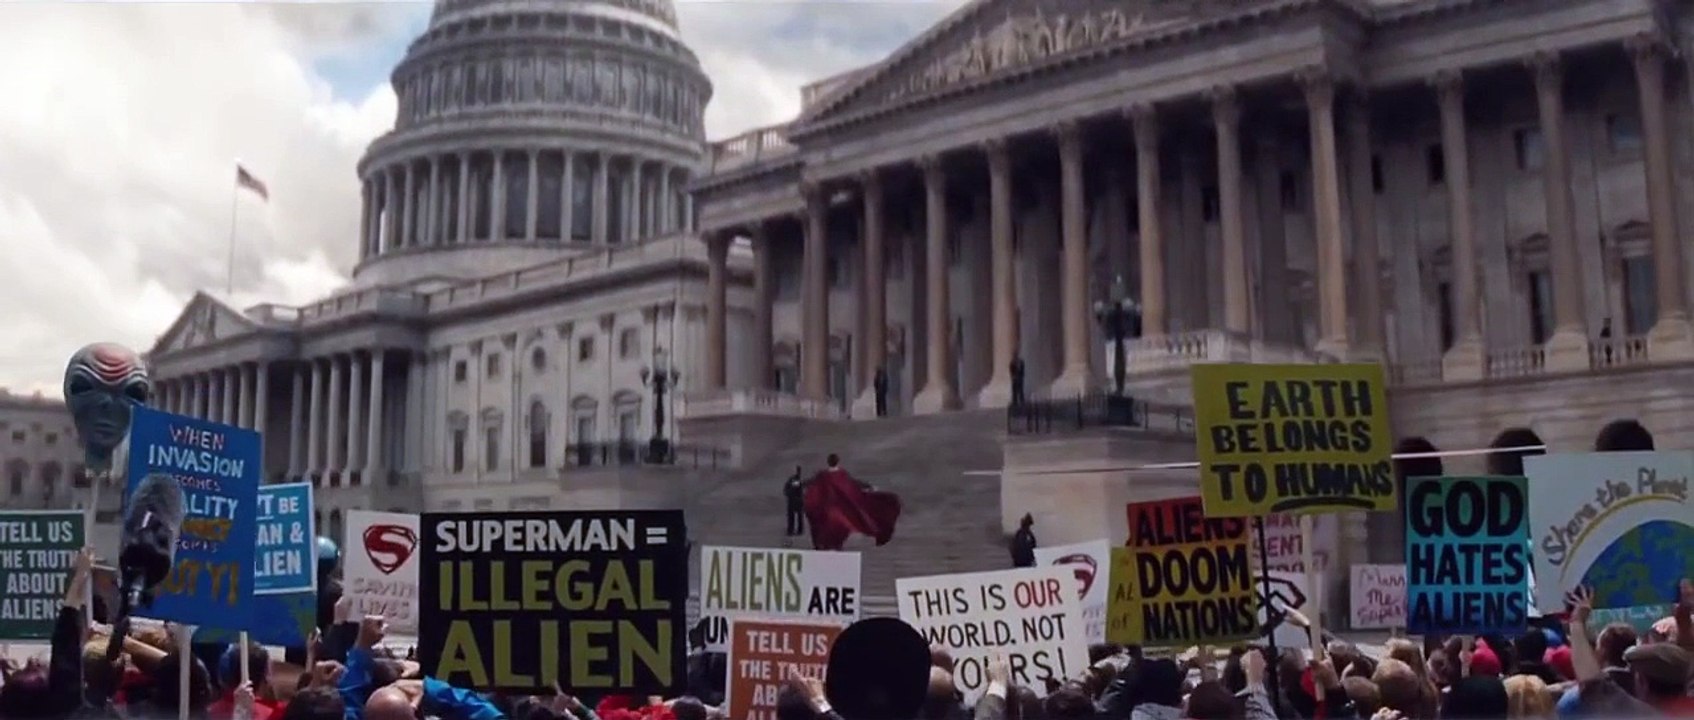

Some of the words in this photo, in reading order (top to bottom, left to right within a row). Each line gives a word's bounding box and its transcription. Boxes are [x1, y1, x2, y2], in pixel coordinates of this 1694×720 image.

[1225, 380, 1373, 419] EARTH
[169, 423, 225, 450] WHEN
[1210, 420, 1372, 454] BELONGS
[148, 443, 244, 479] INVASION
[1210, 463, 1268, 503] TO
[1274, 460, 1393, 498] HUMANS
[278, 496, 300, 515] BE
[1409, 481, 1525, 538] GOD
[0, 521, 43, 543] TELL
[47, 520, 74, 543] US
[289, 521, 305, 545] &
[435, 518, 636, 552] SUPERMAN
[706, 550, 803, 612] ALIENS
[808, 586, 855, 615] ARE
[1136, 543, 1251, 599] DOOM
[1411, 542, 1526, 586] HATES
[6, 572, 67, 594] ABOUT
[438, 559, 671, 611] ILLEGAL
[908, 587, 969, 618] THIS
[980, 583, 1006, 611] IS
[1014, 578, 1063, 609] OUR
[1141, 597, 1255, 640] NATIONS
[1411, 591, 1527, 632] ALIENS
[746, 630, 795, 655] TELL
[801, 633, 828, 657] US
[921, 619, 1017, 649] WORLD.
[1022, 613, 1066, 643] NOT
[435, 619, 673, 687] ALIEN
[740, 659, 771, 680] THE
